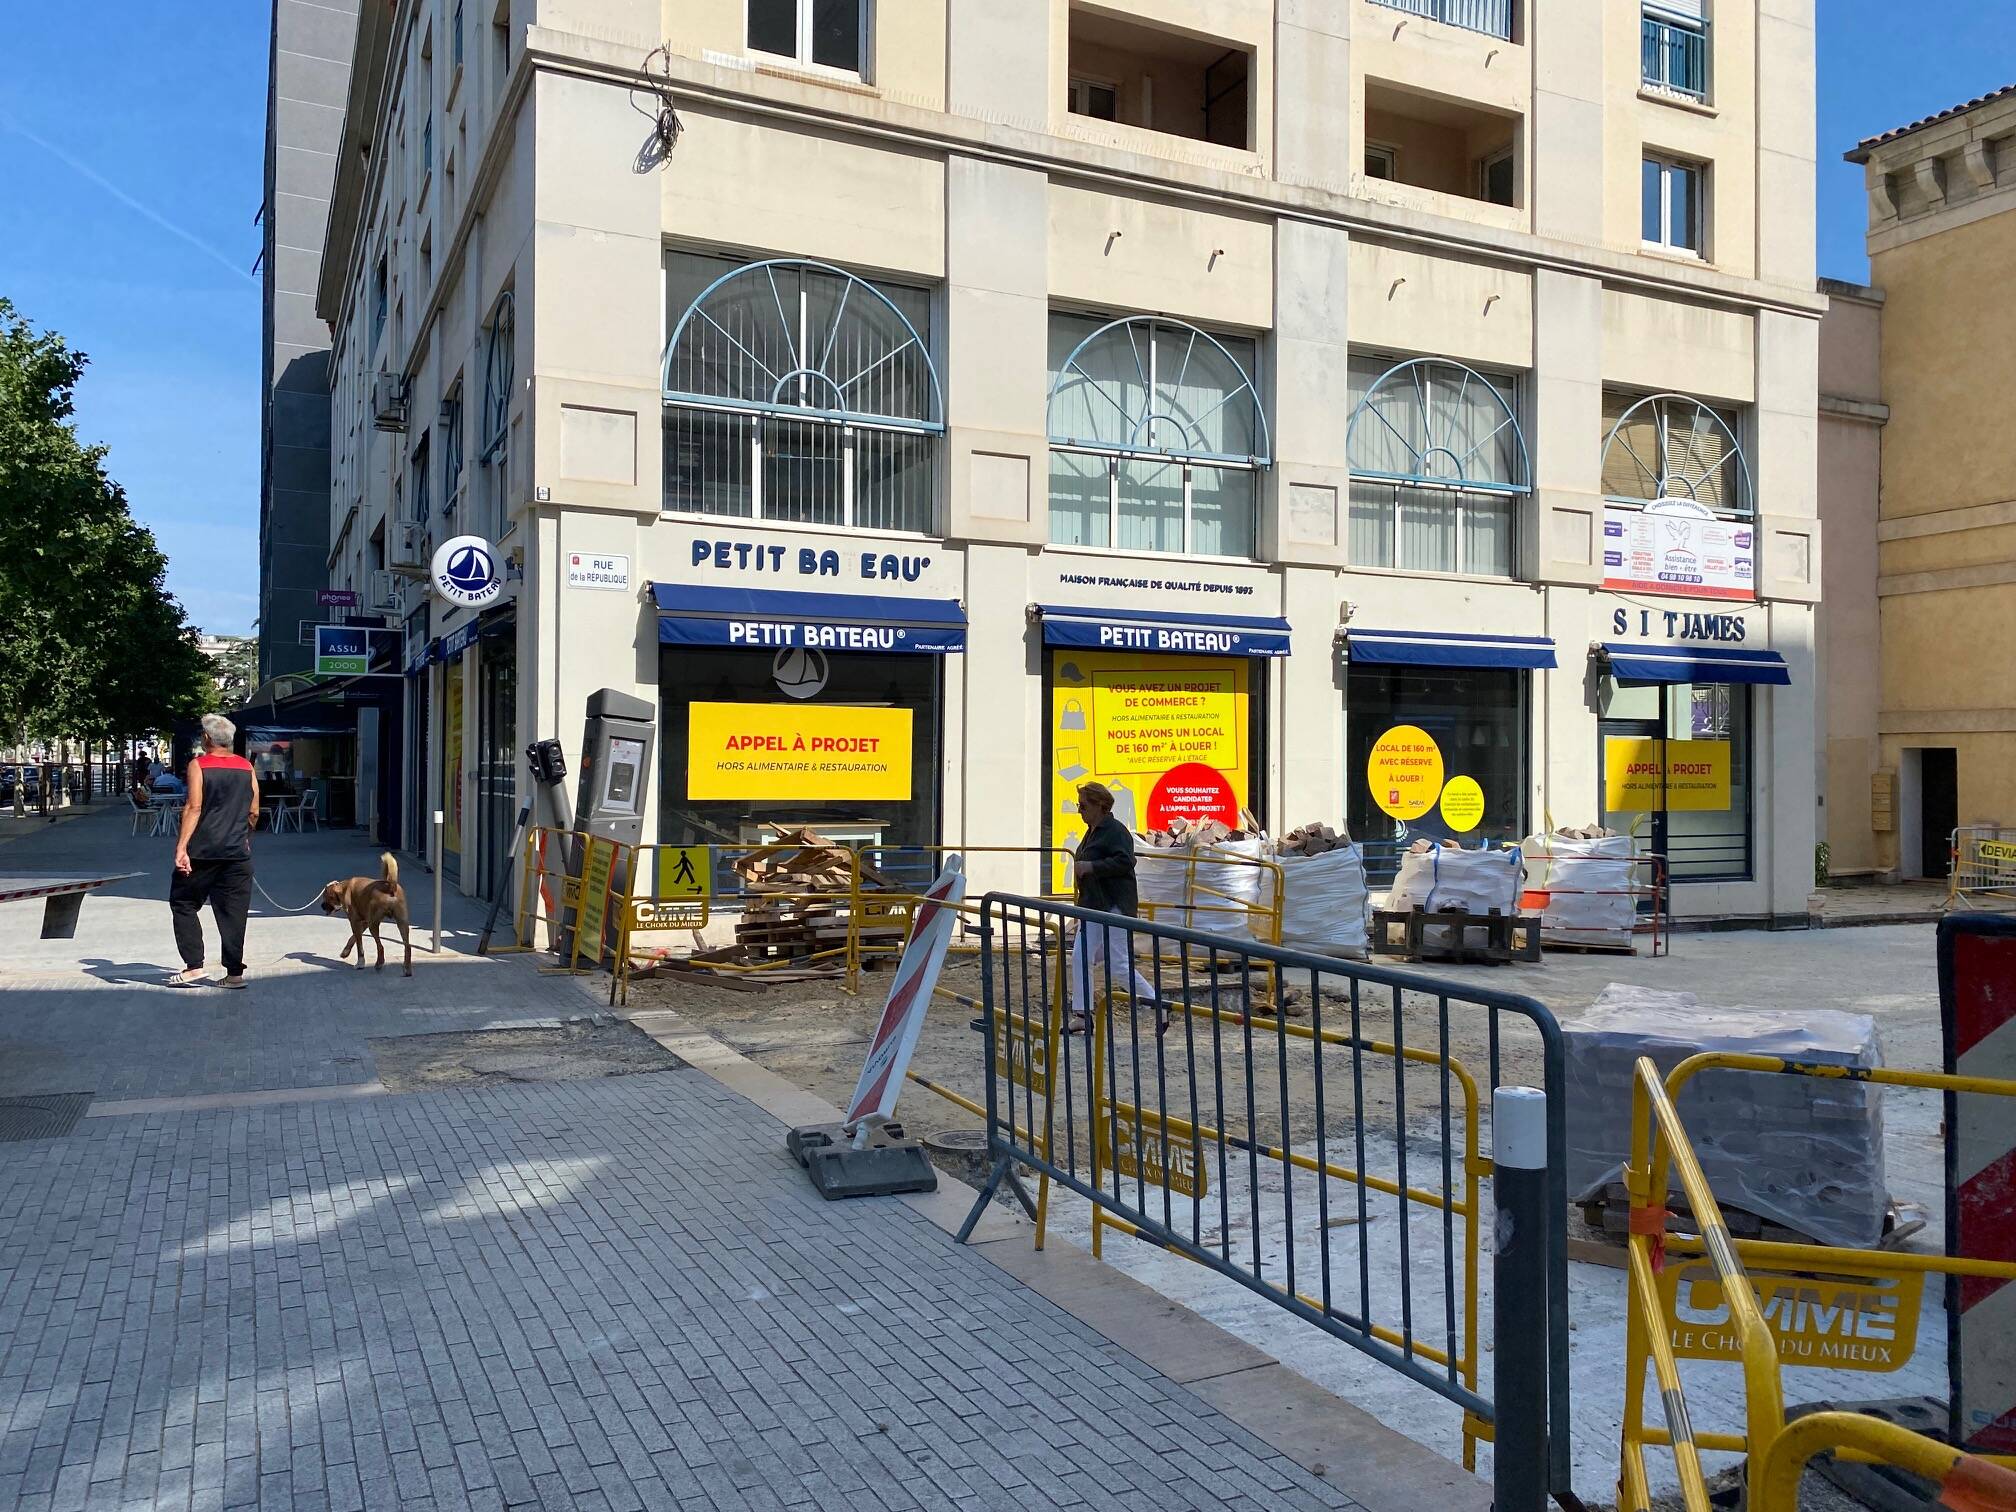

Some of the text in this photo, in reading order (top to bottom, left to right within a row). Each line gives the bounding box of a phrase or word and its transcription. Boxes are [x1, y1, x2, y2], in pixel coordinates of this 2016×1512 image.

[692, 540, 786, 572] PETIT
[1664, 554, 1697, 564] Assistance
[593, 560, 614, 570] RUE
[571, 571, 627, 584] de la RÉPUBLIQUE
[438, 574, 502, 601] PETIT BATEAU
[1060, 574, 1096, 585] MAISON
[1098, 576, 1149, 588] FRANÇAISE
[1151, 580, 1163, 589] DE
[1164, 580, 1202, 591] QUALITÉ
[1203, 583, 1234, 594] DEPUIS
[729, 621, 796, 645] PETIT
[1100, 626, 1153, 648] PETIT
[328, 644, 358, 653] ASSU
[328, 661, 358, 670] 2000
[1108, 682, 1222, 694] VOUS AVEZ UN PROJET
[1125, 698, 1139, 707] DE
[1141, 697, 1198, 707] COMMERCE
[1130, 713, 1171, 721] ALIMENTAIRE
[1107, 727, 1225, 739] NOUS AVONS UN LOCAL
[725, 733, 880, 753] APPEL À PROJET
[1116, 744, 1131, 753] DE
[1133, 743, 1149, 753] 160
[1179, 741, 1212, 752] LOUER
[1376, 744, 1400, 753] LOCAL
[1401, 744, 1412, 752] DE
[1413, 745, 1425, 753] 160
[716, 761, 888, 772] HORS ALIMENTAIRE & RESTAURATION
[1379, 758, 1399, 766] AVEC
[1626, 763, 1661, 775] APPEL
[1673, 763, 1713, 775] PROJET
[1396, 775, 1420, 783] LOUER
[1672, 1329, 1694, 1349] LE
[1780, 1339, 1813, 1356] DU
[1819, 1341, 1892, 1363] MIEUX
